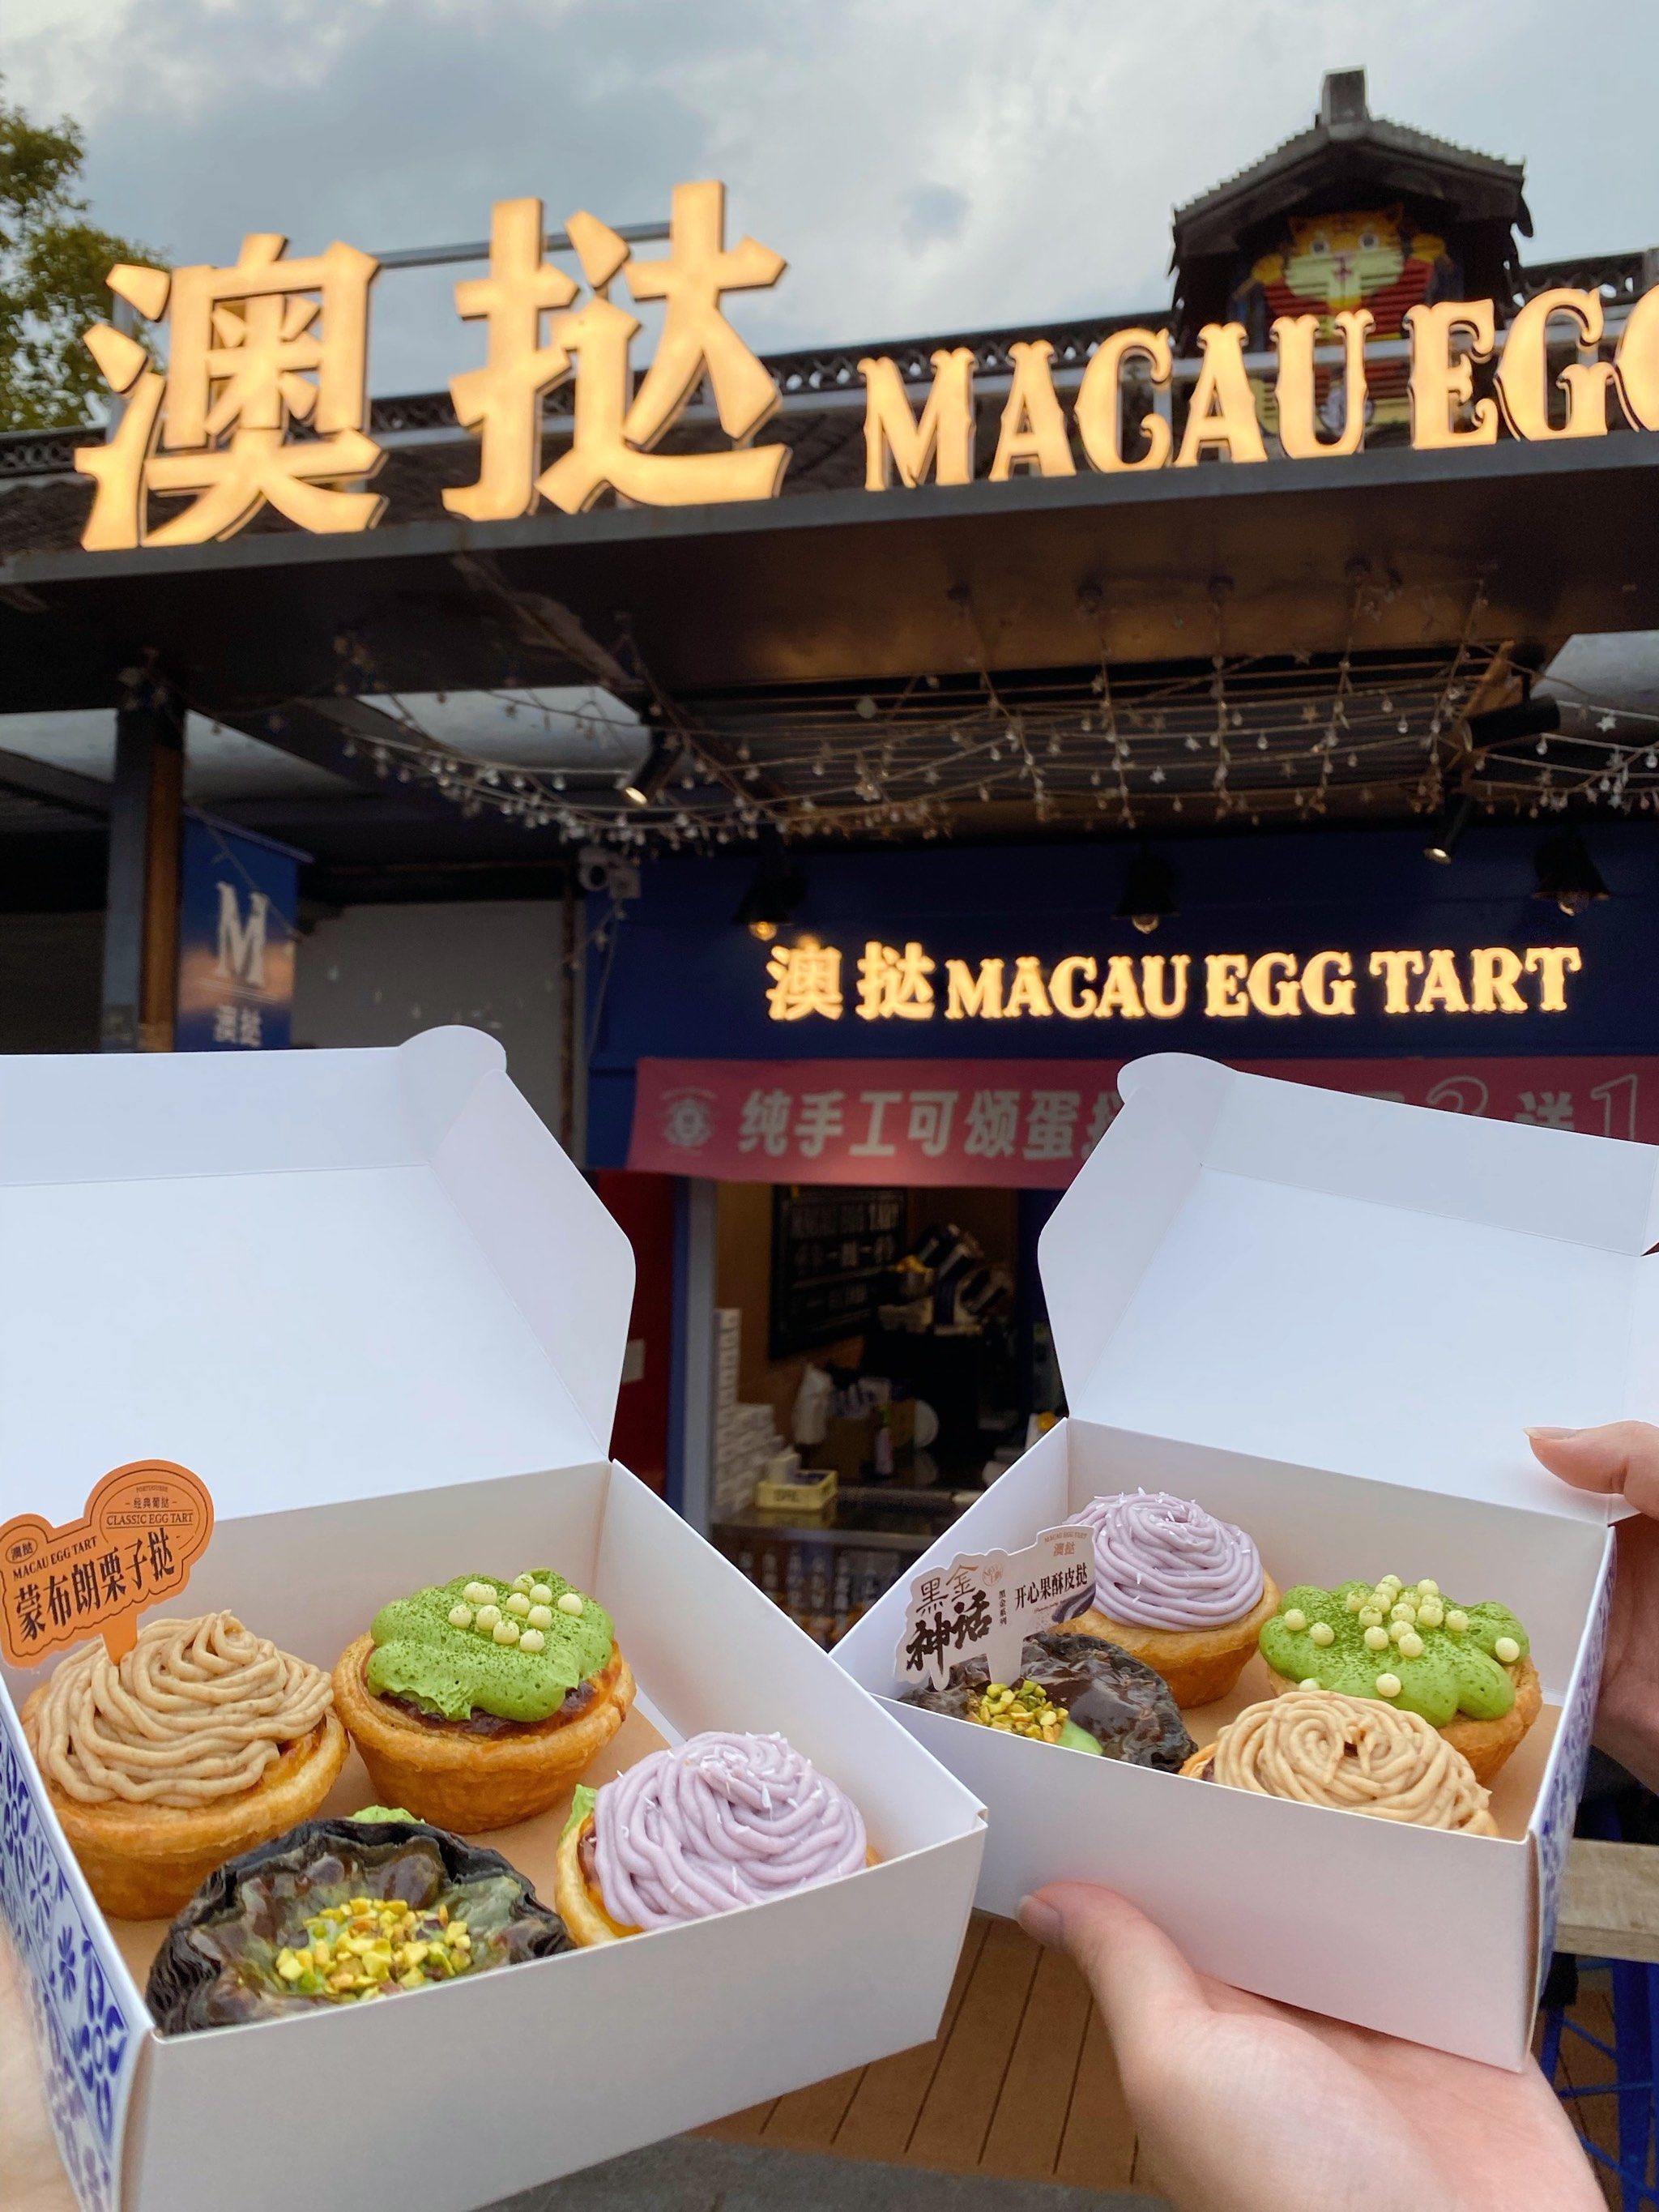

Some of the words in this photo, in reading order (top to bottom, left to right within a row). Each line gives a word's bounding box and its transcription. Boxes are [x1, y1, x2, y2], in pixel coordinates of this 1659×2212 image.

[74, 180, 789, 551] 澳挞
[858, 310, 1374, 491] MACAU
[216, 881, 269, 989] M
[766, 942, 936, 1021] 澳挞
[944, 954, 1191, 1020] MACAU
[1204, 951, 1357, 1018] EGG
[1369, 946, 1581, 1014] TART
[106, 1514, 147, 1526] CLASSIC
[149, 1513, 168, 1524] EGG
[170, 1512, 193, 1523] TART
[13, 1556, 49, 1582] MACAU
[50, 1547, 71, 1565] EGG
[71, 1535, 97, 1556] TART
[14, 1527, 175, 1643] 蒙布朗栗子挞
[916, 1565, 979, 1616] 黑金
[1014, 1562, 1088, 1611] 开心果酥皮挞
